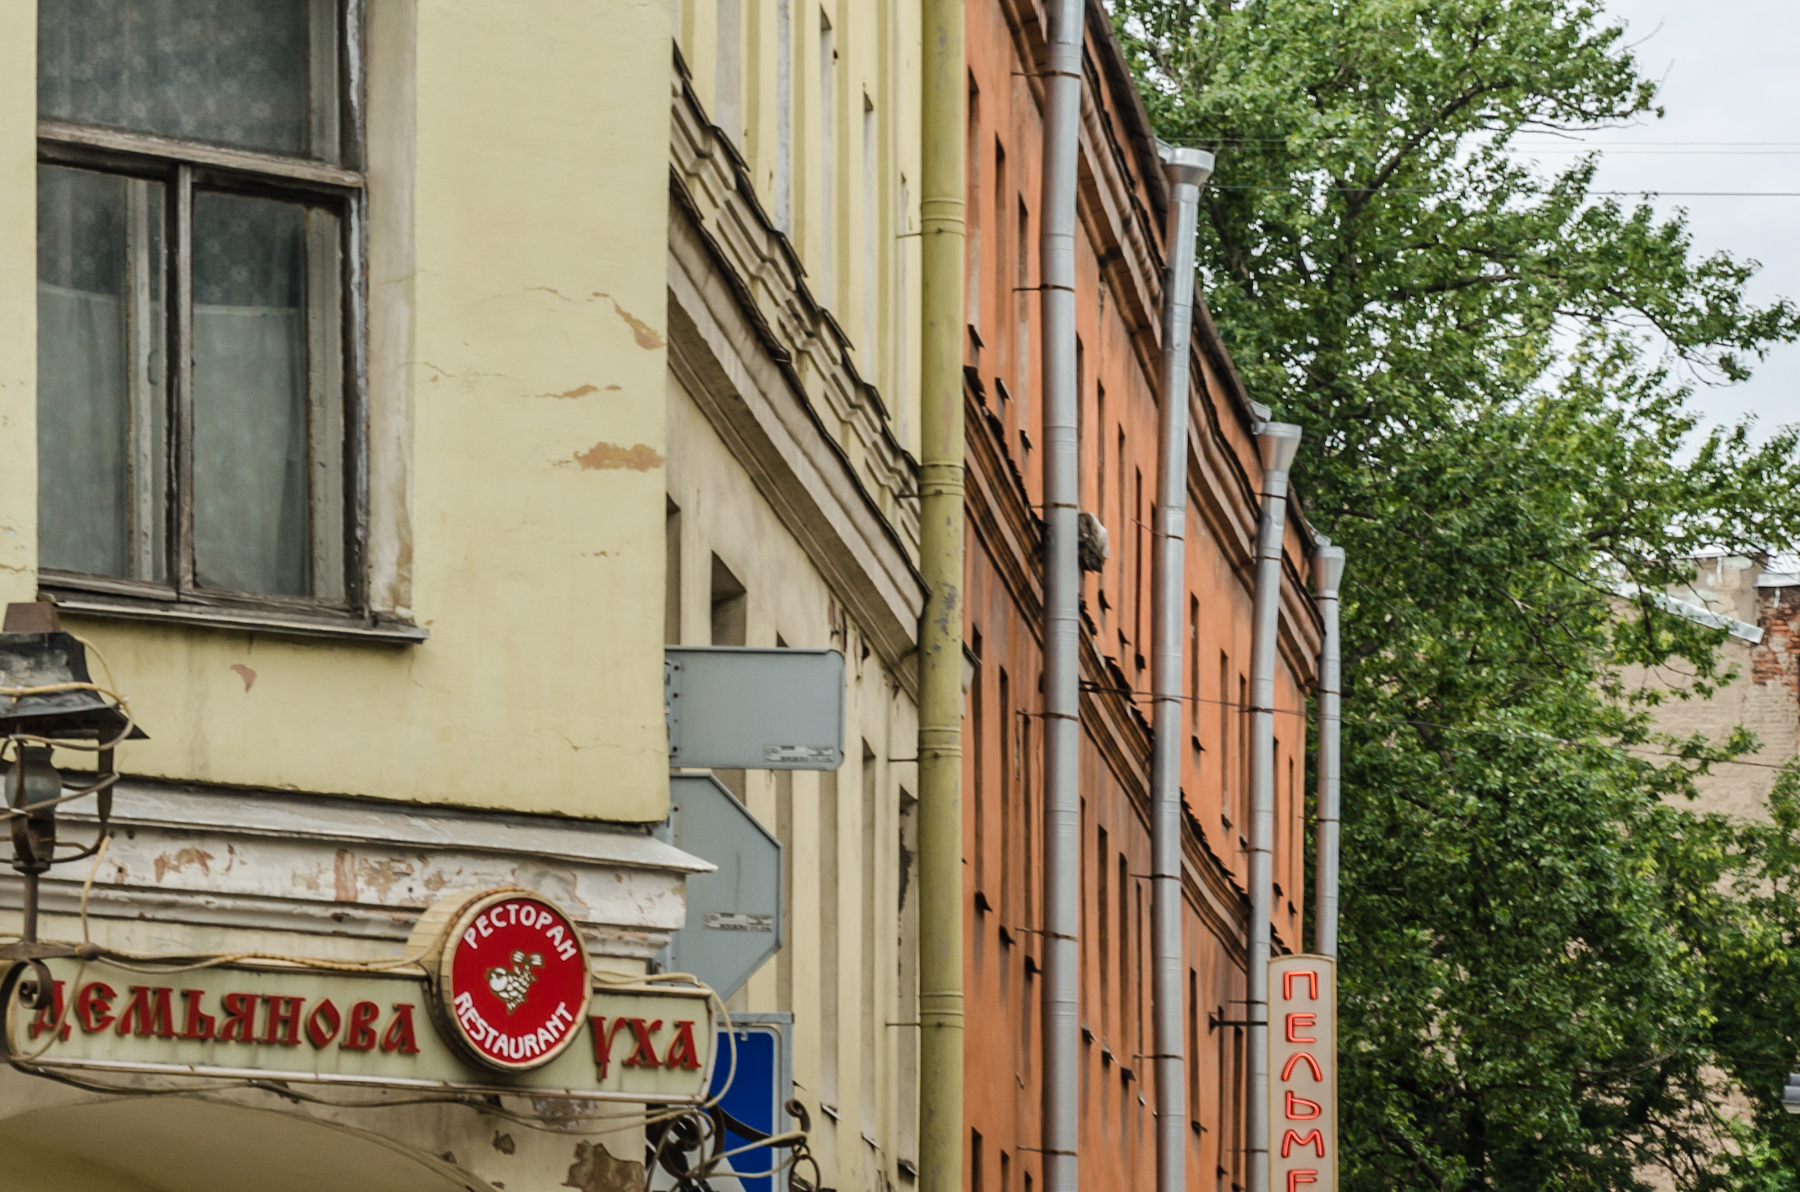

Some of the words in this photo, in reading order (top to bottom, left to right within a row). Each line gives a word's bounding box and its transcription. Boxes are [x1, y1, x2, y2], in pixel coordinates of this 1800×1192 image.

[463, 903, 577, 961] РЕСТОРАН
[28, 979, 422, 1055] ДЕМЬЯНОВА
[588, 1015, 702, 1080] УХА
[454, 991, 573, 1059] RESTAURANT
